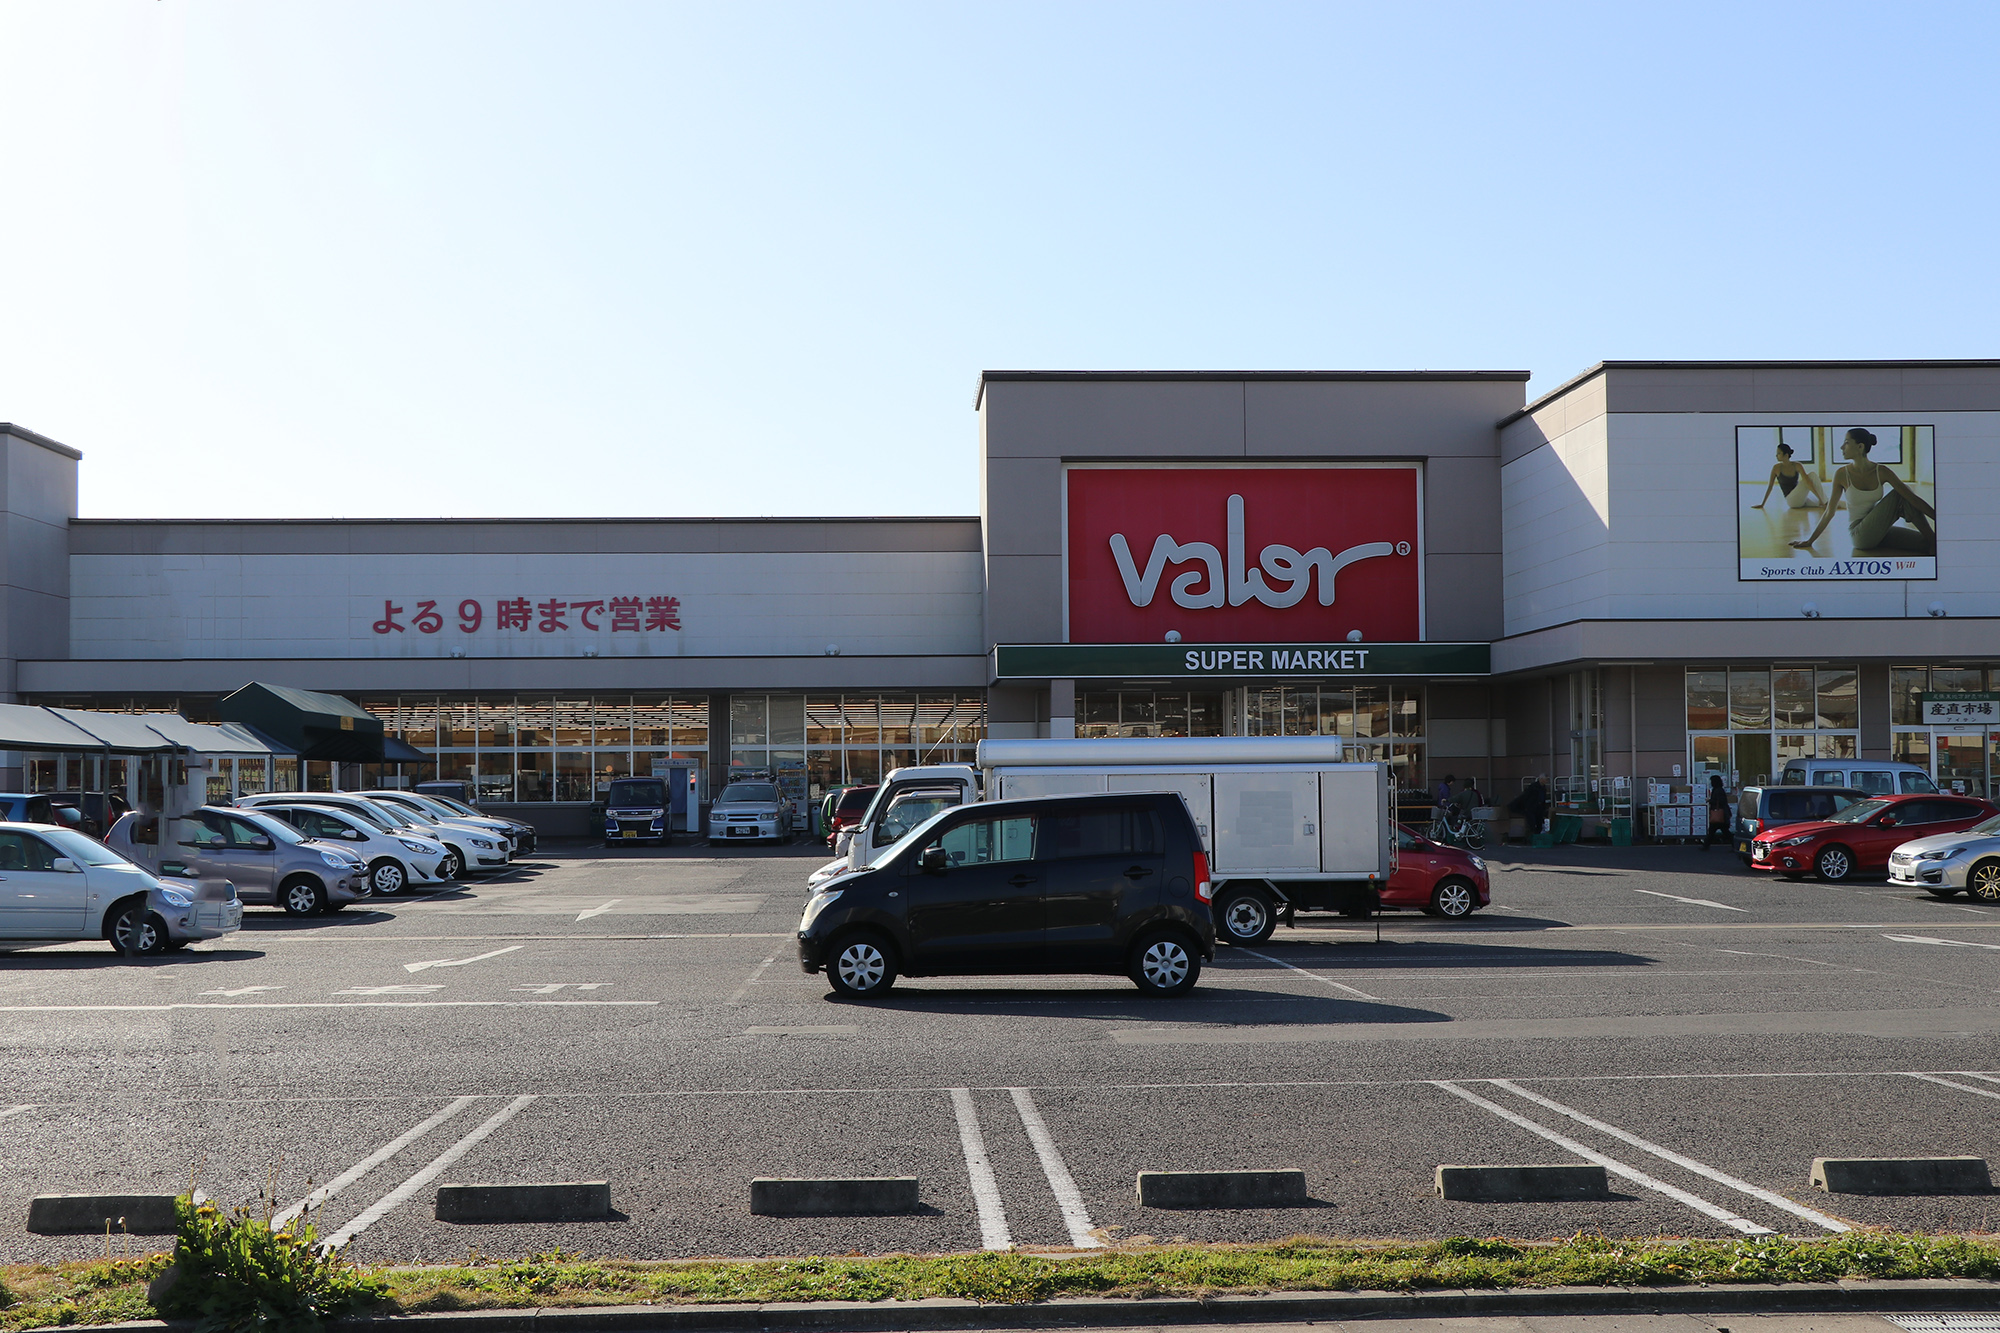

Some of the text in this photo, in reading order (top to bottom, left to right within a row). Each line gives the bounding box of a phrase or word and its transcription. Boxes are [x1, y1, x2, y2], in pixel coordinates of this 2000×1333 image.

[1760, 566, 1796, 577] Sports
[1800, 566, 1825, 576] Club
[1829, 560, 1892, 576] AXTOS
[1185, 650, 1369, 671] SUPER MARKET
[1930, 702, 1993, 716] 産直市場
